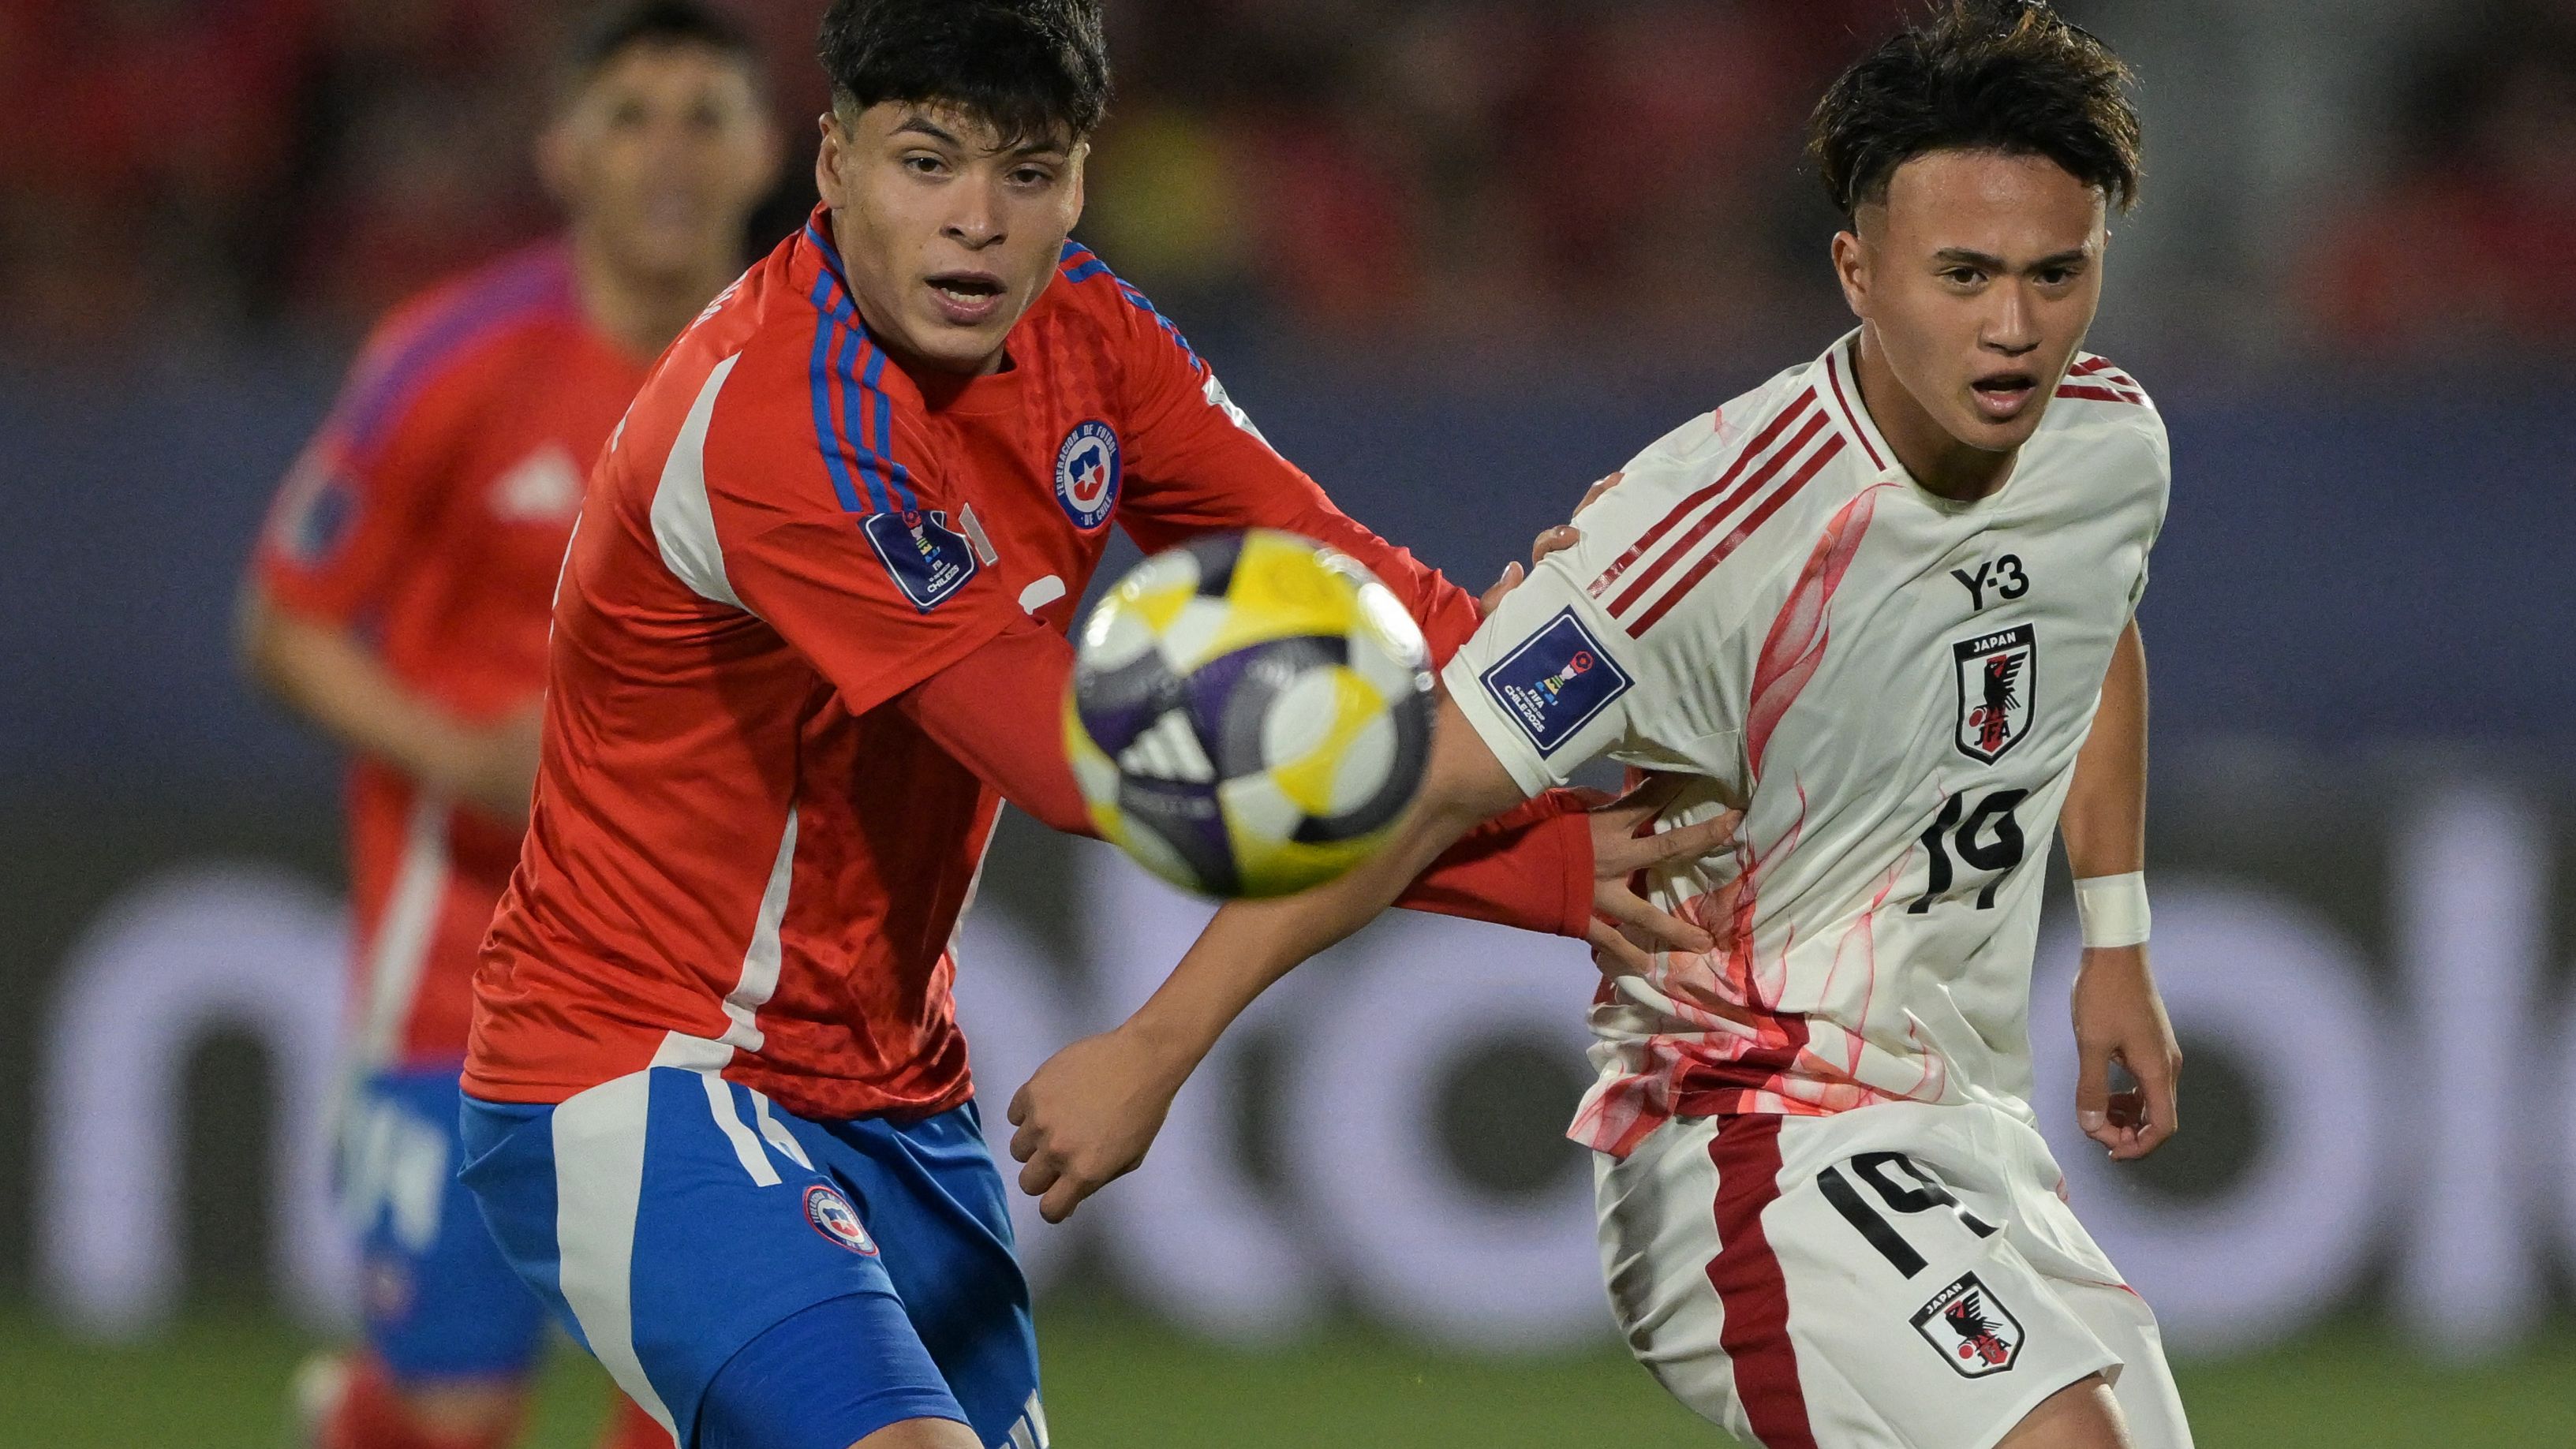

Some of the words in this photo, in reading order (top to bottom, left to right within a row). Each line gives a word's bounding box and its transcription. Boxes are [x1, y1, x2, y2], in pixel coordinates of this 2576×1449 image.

[1056, 430, 1079, 496] FEDERACION
[1083, 424, 1094, 435] DE
[1096, 426, 1117, 457] FUTBOL
[1084, 513, 1094, 526] DE
[1097, 495, 1113, 521] CHILE
[1950, 554, 2030, 611] Y-3
[1973, 632, 2017, 653] JAPAN
[1527, 689, 1544, 708] FIFA
[1974, 720, 2012, 746] JFA
[1907, 788, 2029, 915] 19
[1816, 1151, 2000, 1281] 19
[1926, 1283, 1964, 1315] JAPAN
